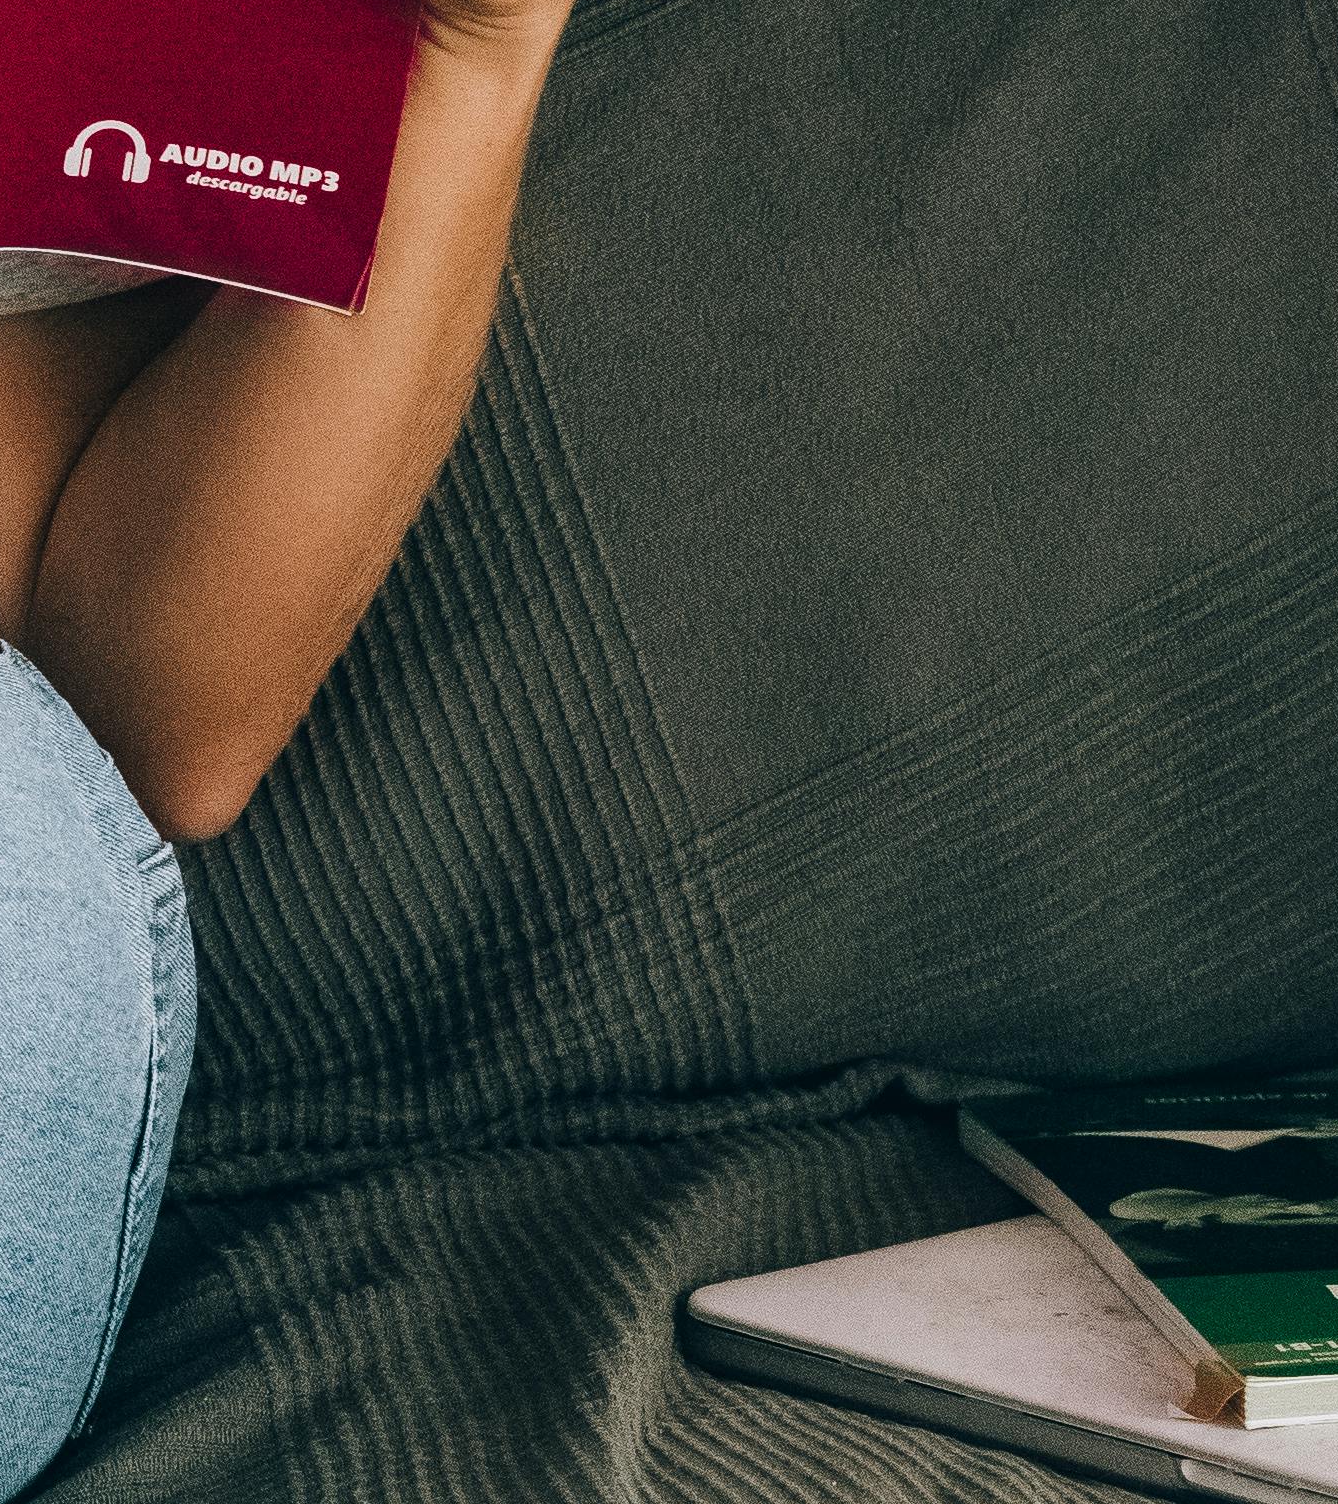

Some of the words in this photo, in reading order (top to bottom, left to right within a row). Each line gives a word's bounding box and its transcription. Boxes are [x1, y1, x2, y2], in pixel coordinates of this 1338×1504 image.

[159, 143, 264, 178] AUDIO
[267, 159, 341, 193] MP3
[185, 169, 309, 206] descargable
